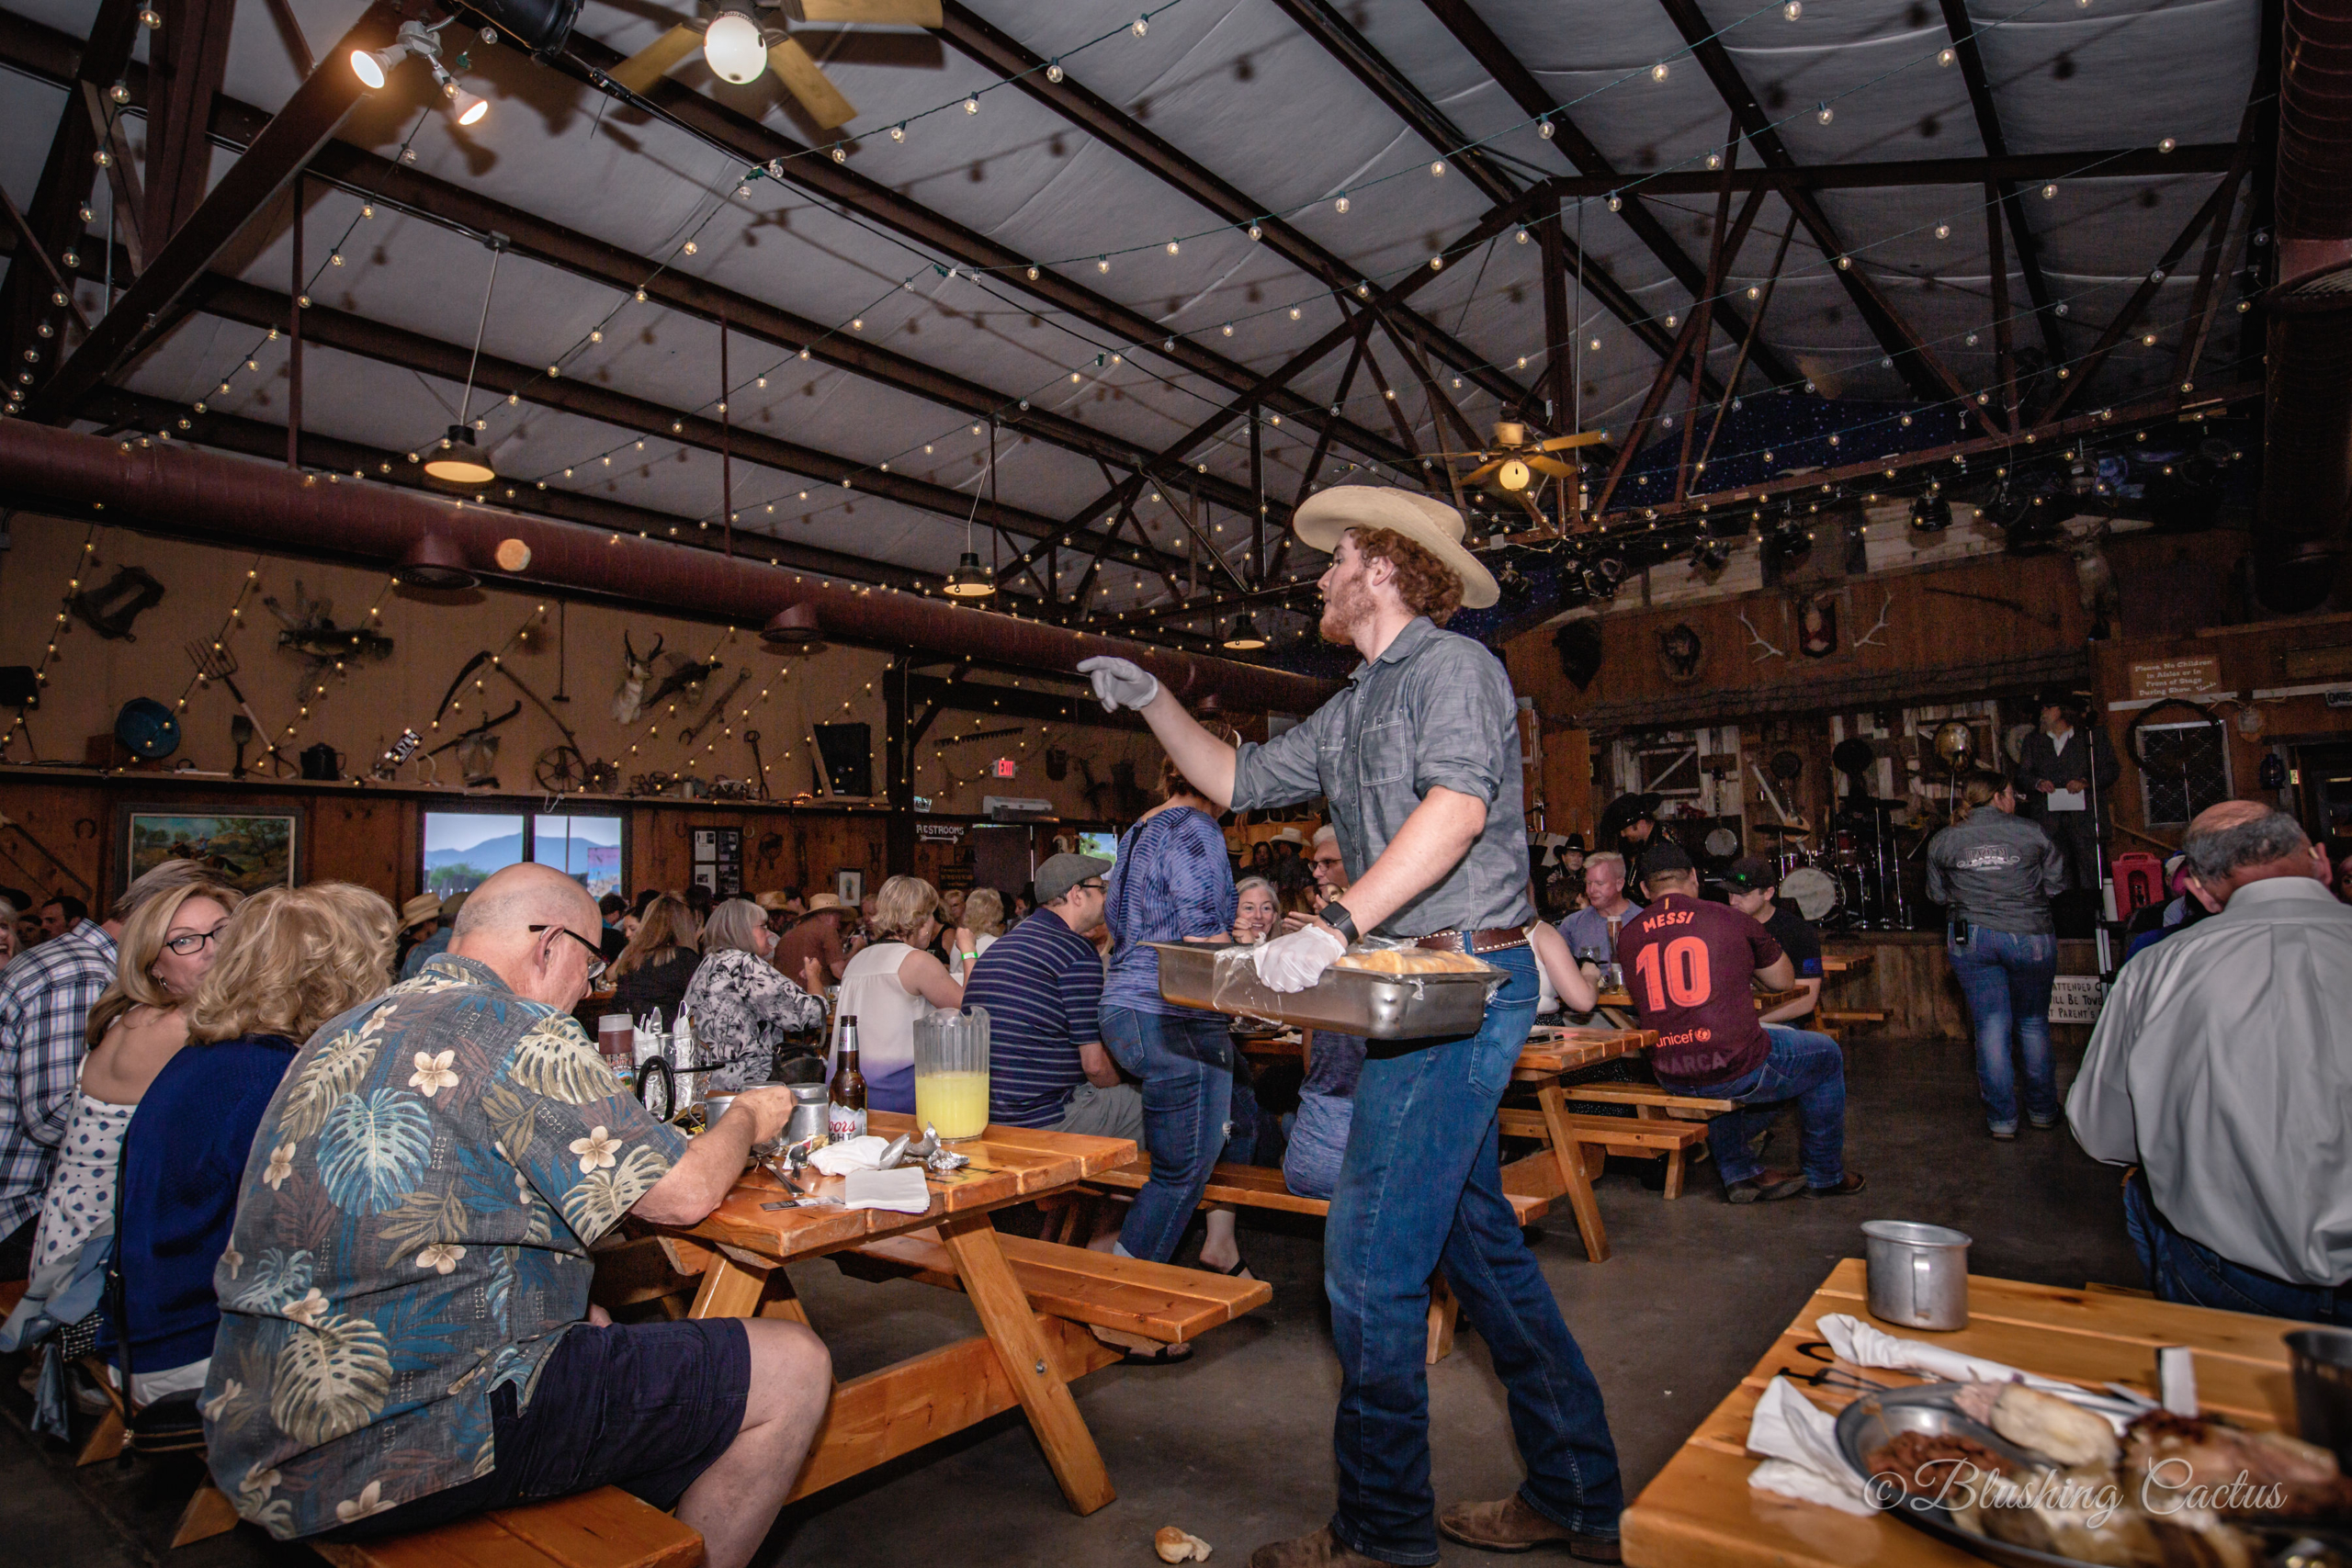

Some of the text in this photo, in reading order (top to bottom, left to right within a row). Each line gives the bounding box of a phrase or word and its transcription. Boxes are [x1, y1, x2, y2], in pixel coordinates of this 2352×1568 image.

[2177, 660, 2212, 668] Children
[2139, 688, 2166, 696] During
[998, 761, 1014, 776] EXIT
[916, 824, 965, 835] RESTROOMS
[1642, 910, 1695, 933] MESSI
[1635, 935, 1712, 1011] 10
[1656, 1029, 1693, 1048] unicef
[829, 1120, 856, 1134] oors
